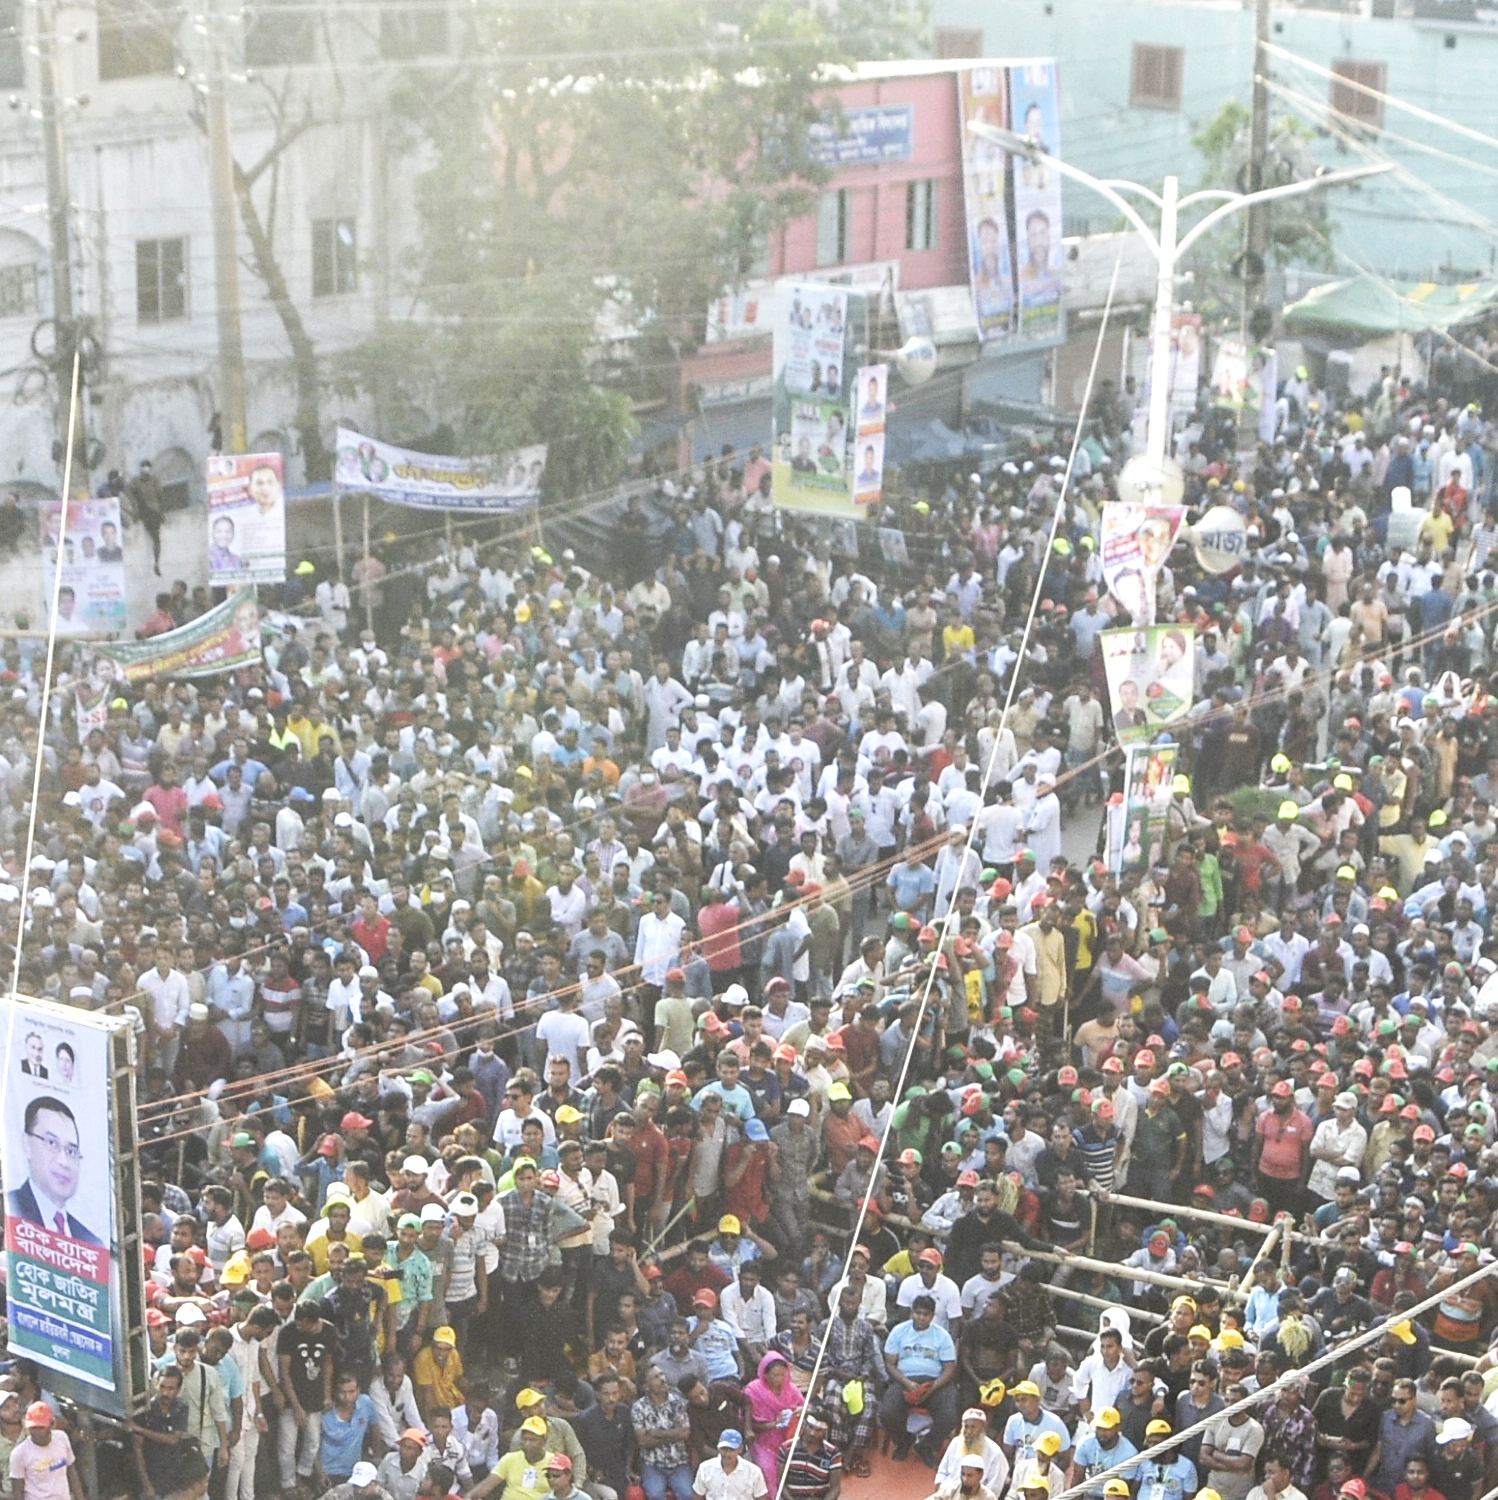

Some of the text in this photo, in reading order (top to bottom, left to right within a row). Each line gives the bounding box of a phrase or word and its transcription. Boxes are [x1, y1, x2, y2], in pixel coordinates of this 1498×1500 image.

[14, 1234, 99, 1280] বাংলাদেশ
[15, 1220, 100, 1264] টেক ব্যাক
[15, 1260, 100, 1306] হোক জাতির
[17, 1278, 98, 1324] মূলমন্ত্র
